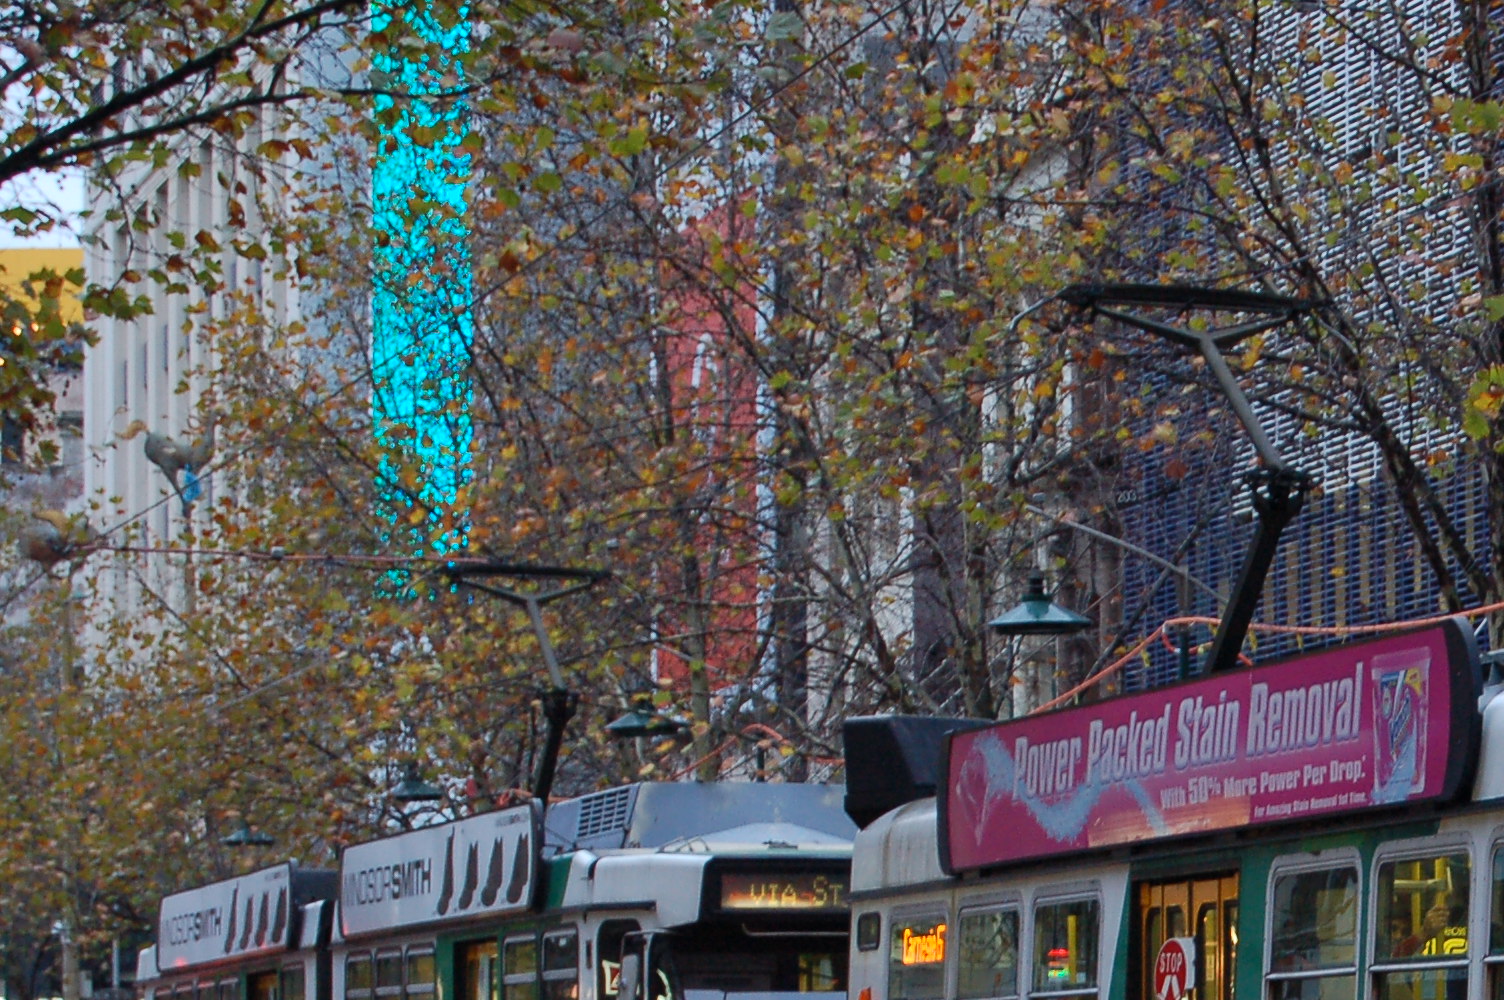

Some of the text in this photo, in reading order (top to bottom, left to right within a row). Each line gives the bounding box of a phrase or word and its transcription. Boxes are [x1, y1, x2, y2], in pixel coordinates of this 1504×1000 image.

[1012, 661, 1364, 801] Power Packed Stain Removal
[1160, 785, 1186, 810] With
[1188, 775, 1221, 805] 50%
[1223, 777, 1257, 799] More
[1260, 769, 1301, 794] Power
[1303, 763, 1327, 787] Per
[750, 883, 797, 905] VIA
[1159, 951, 1183, 974] STOP
